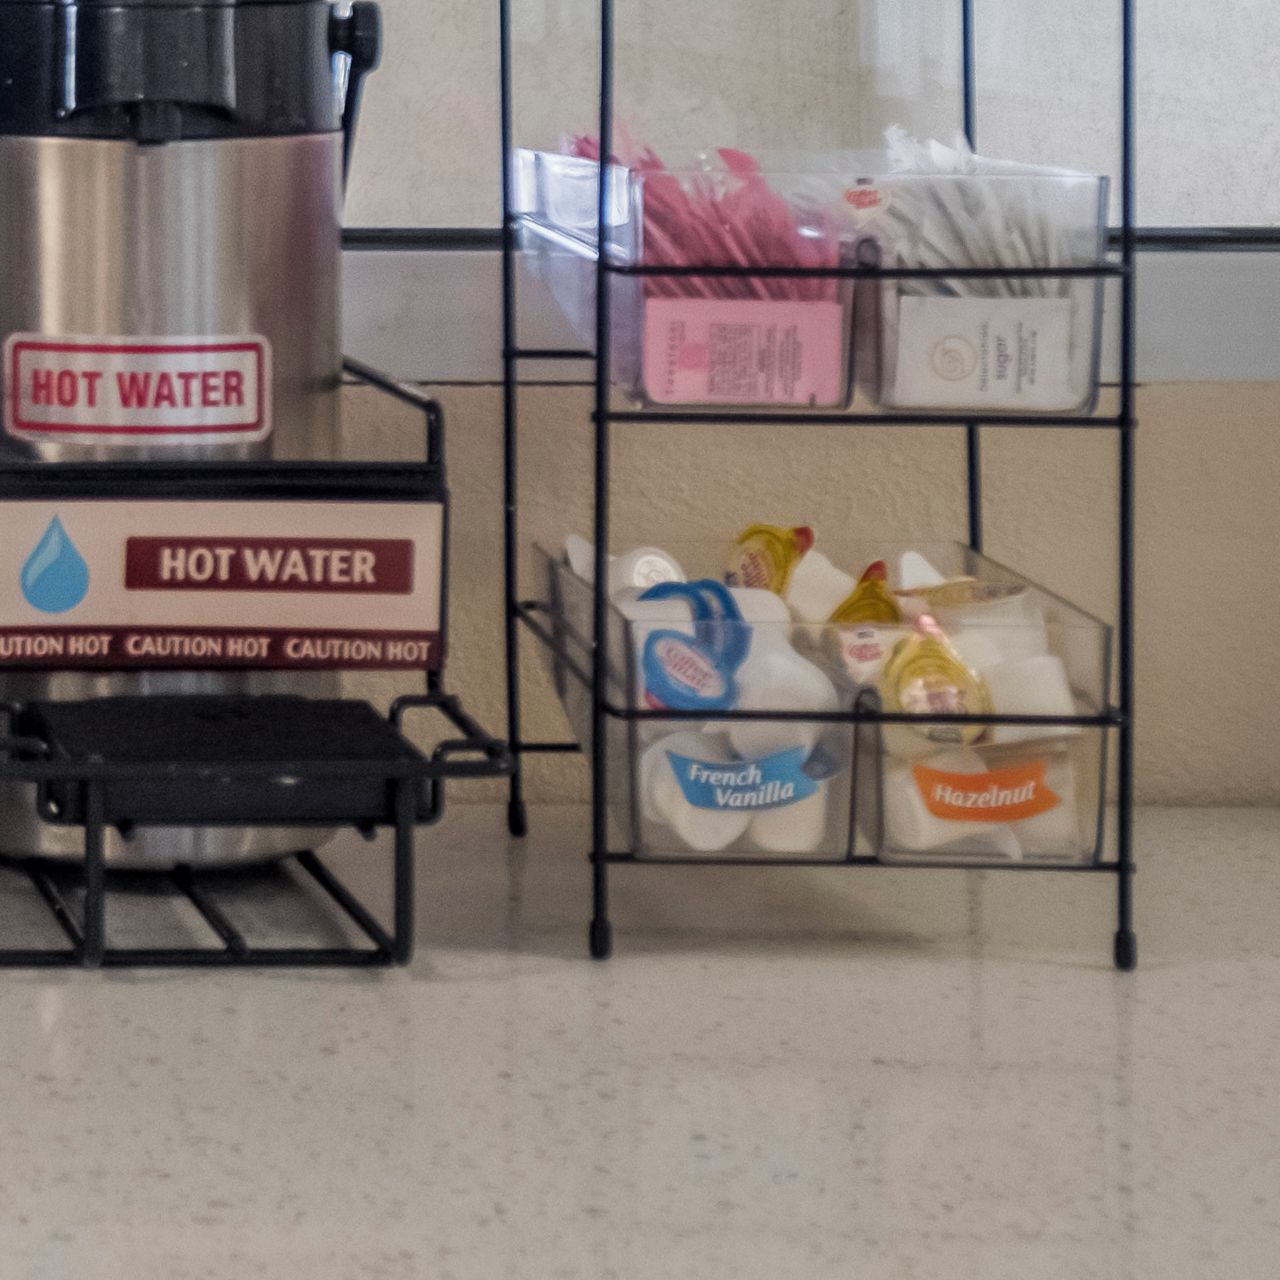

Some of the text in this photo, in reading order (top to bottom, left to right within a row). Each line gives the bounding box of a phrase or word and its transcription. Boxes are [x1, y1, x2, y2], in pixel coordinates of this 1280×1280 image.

[992, 335, 1012, 380] sugar
[31, 369, 245, 408] HOT WATER
[160, 547, 377, 583] HOT WATER
[68, 636, 113, 656] HOT
[125, 636, 223, 658] CAUTION
[227, 637, 271, 658] HOT
[285, 638, 383, 661] CAUTION
[387, 640, 431, 662] HOT
[688, 763, 762, 787] French
[715, 780, 795, 808] Vanilla
[933, 780, 1037, 809] Hazelnut
